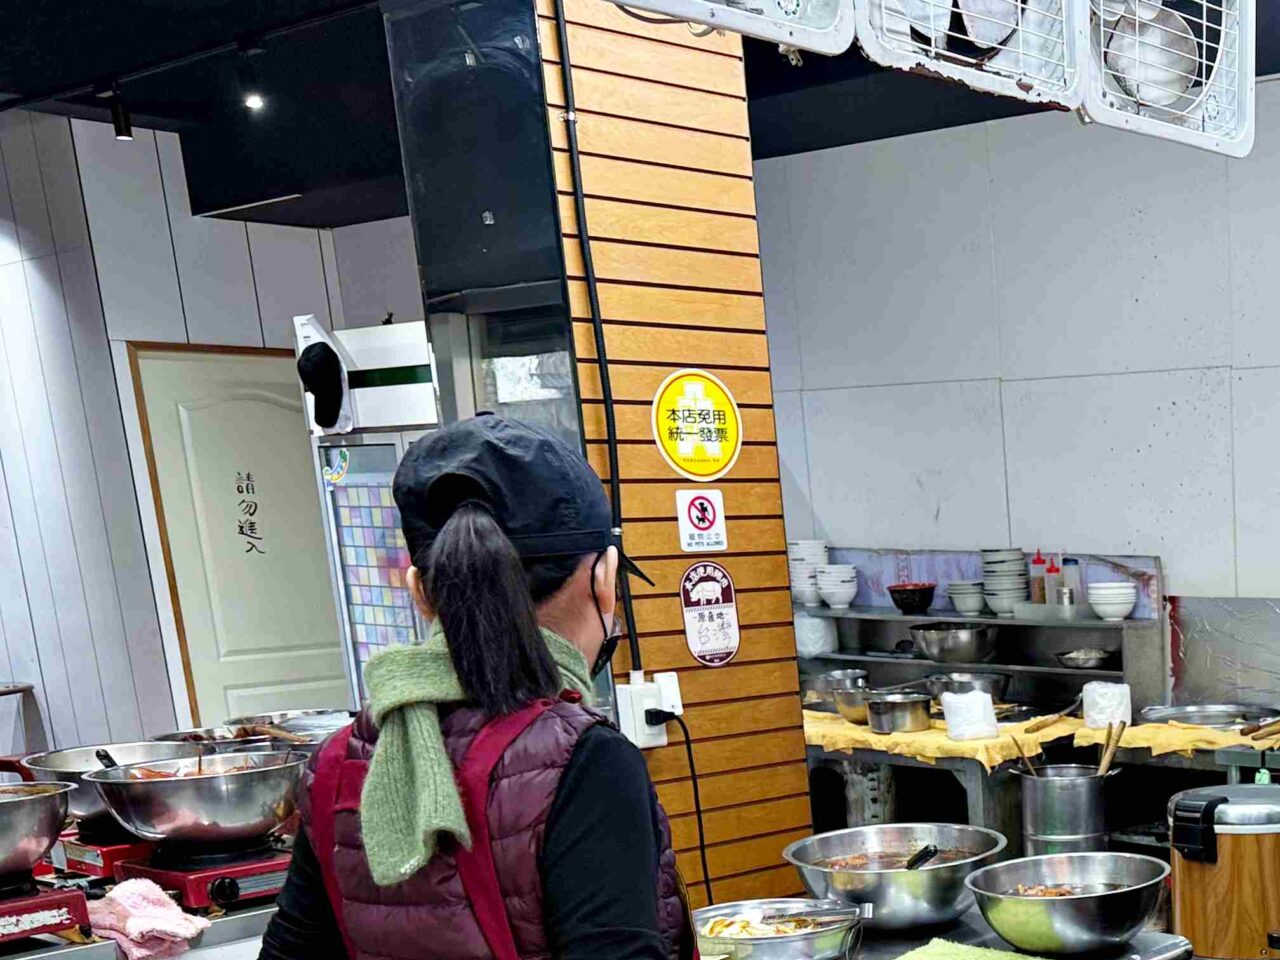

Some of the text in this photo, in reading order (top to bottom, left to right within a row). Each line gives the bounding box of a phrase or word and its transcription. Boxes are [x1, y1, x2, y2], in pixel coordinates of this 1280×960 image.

[666, 408, 727, 425] 本店免用
[668, 426, 729, 443] 統一發票
[236, 471, 265, 554] 請勿進入
